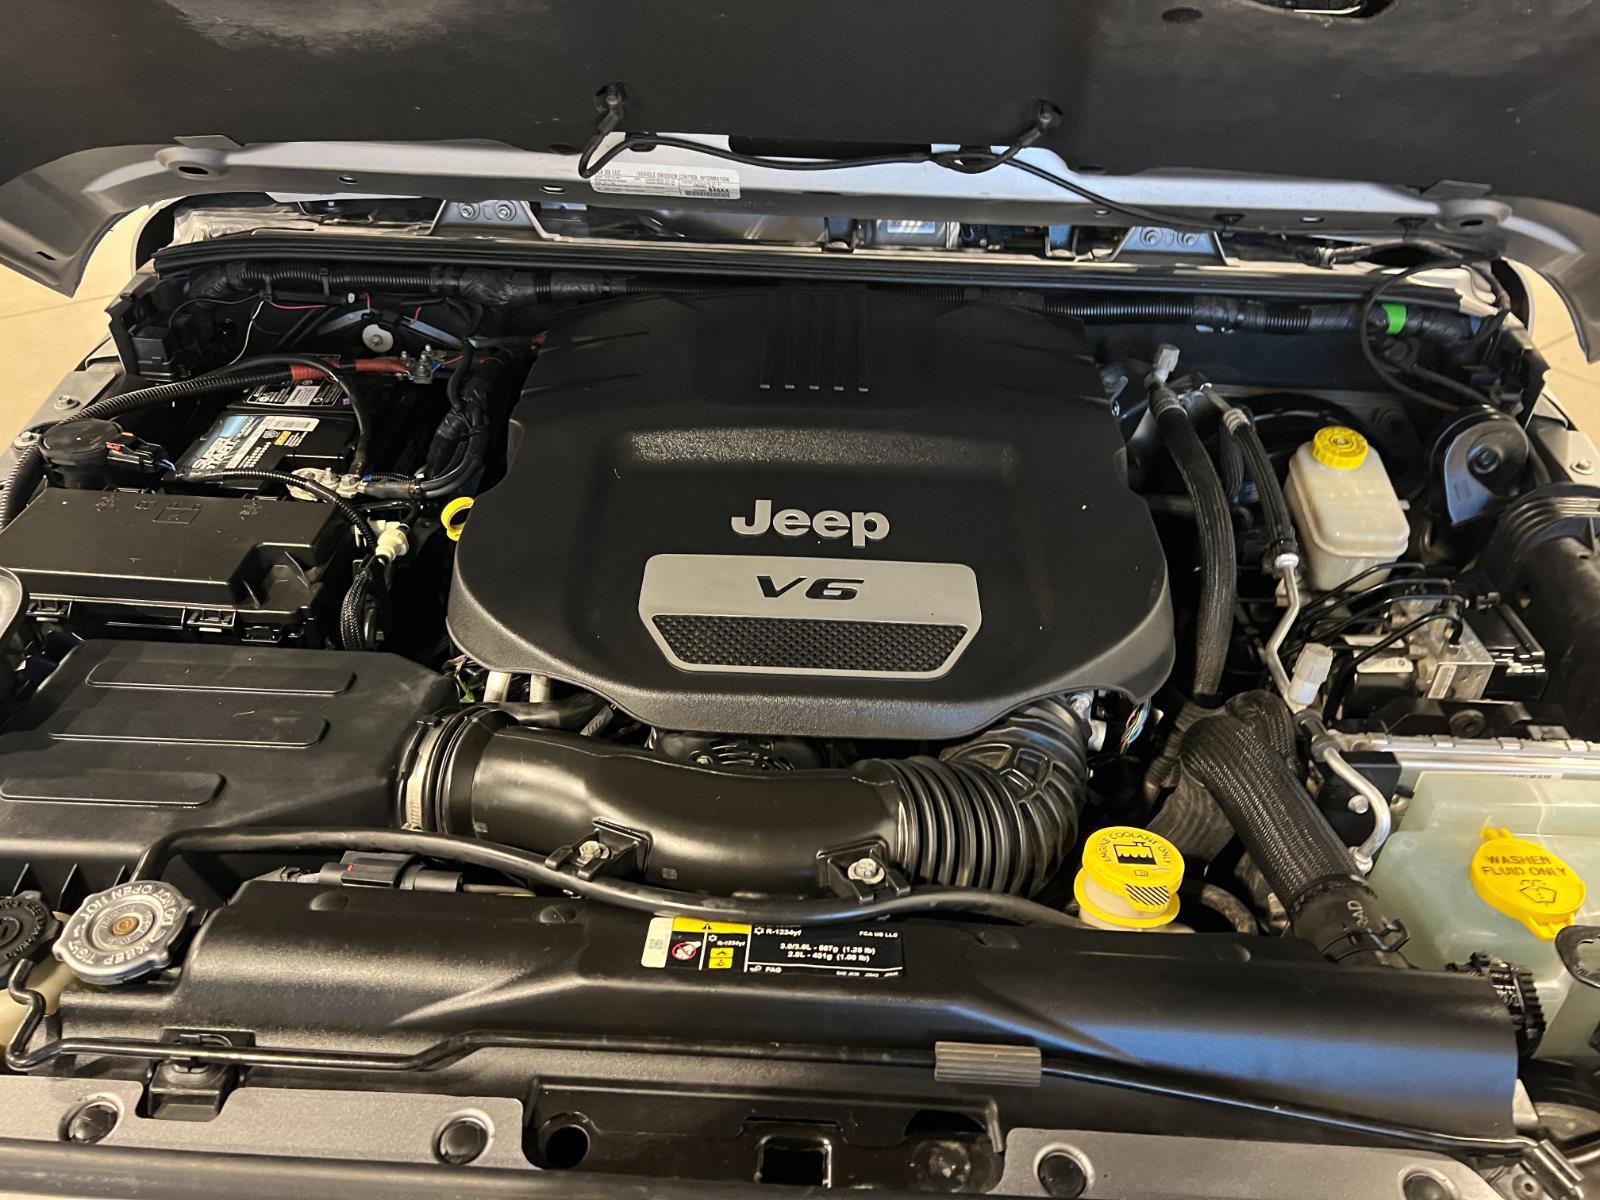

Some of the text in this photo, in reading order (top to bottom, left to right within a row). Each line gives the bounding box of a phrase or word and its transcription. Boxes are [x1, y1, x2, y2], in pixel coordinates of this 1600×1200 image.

[637, 170, 656, 178] VEHICLE
[731, 499, 890, 548] Jeep
[756, 575, 866, 601] V6
[1109, 831, 1157, 845] COOLANT
[1157, 845, 1172, 864] ONLY
[1486, 854, 1552, 865] WASHER
[1481, 865, 1567, 877] FLUID ONLY
[111, 884, 153, 900] OPEN
[79, 895, 110, 921] HOT
[765, 927, 802, 937] R-1234yf
[858, 930, 873, 938] FCA
[103, 941, 151, 966] KEEP
[765, 966, 782, 974] PAG
